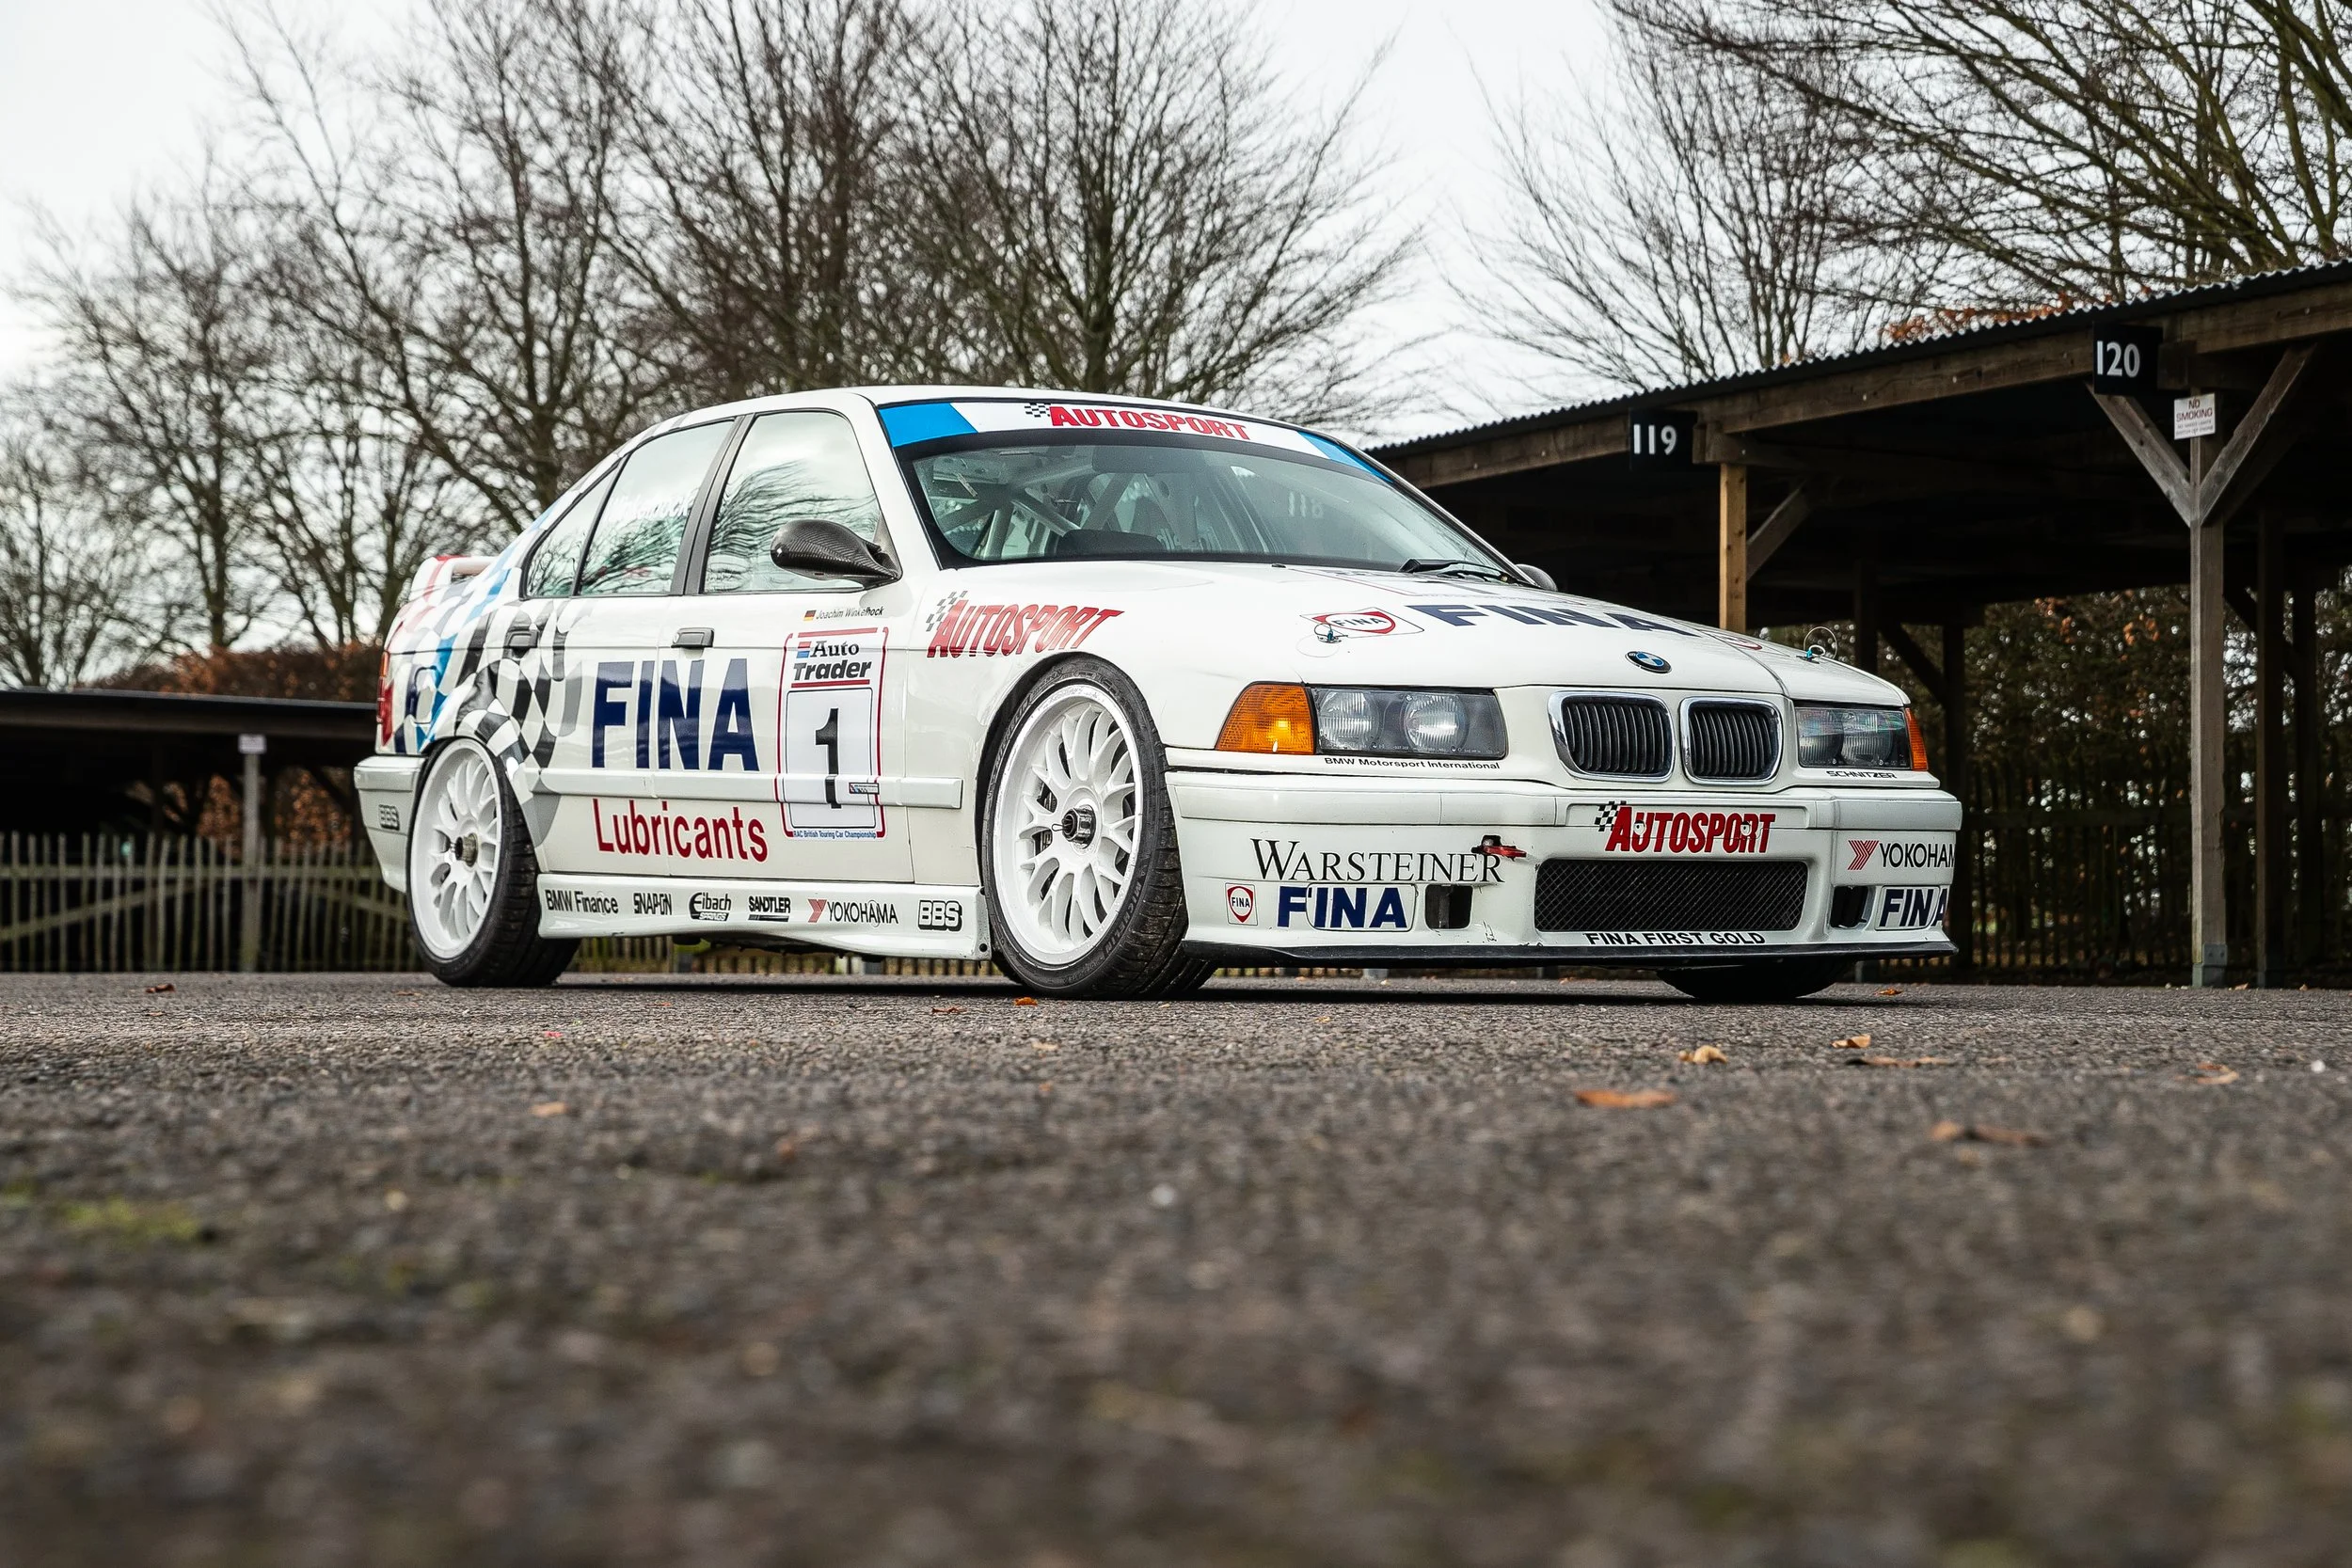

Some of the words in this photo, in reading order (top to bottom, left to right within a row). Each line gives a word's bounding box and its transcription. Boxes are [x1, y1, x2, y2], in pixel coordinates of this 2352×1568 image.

[2096, 341, 2140, 378] 120
[2176, 407, 2213, 422] SMOKING
[2188, 398, 2201, 409] NO
[1049, 405, 1250, 440] AUTOSPORT
[1633, 423, 1677, 455] 119
[816, 608, 844, 620] Joachim
[845, 606, 884, 618] Winkelhock
[1331, 617, 1388, 626] FINA
[1404, 604, 1702, 638] FINA
[927, 600, 1124, 657] AUTOSPORT
[810, 641, 860, 657] Auto
[793, 659, 872, 681] Trader
[592, 658, 760, 771] FINA
[816, 708, 841, 808] 1
[1324, 756, 1355, 766] BMW
[1359, 758, 1426, 768] Motorsport
[1427, 760, 1501, 770] International
[1826, 770, 1898, 780] SCHNITZER
[592, 799, 768, 863] Lubricants
[804, 830, 818, 838] British
[818, 830, 835, 840] Touring
[835, 830, 844, 838] Car
[845, 830, 877, 839] Championship
[1604, 806, 1776, 854] AUTOSPORT
[1250, 837, 1505, 883] WARSTEINER
[545, 889, 573, 912] BMW
[574, 891, 619, 914] Finance
[689, 892, 732, 914] Eibach
[748, 895, 791, 914] SANDTLER
[827, 899, 899, 925] YOKOHAMA
[1232, 896, 1250, 909] FINA
[1277, 886, 1408, 929] FINA
[1879, 888, 1948, 927] FINA
[918, 899, 962, 931] BBS
[1584, 932, 1641, 945] FINA
[1642, 932, 1705, 945] FIRST
[1708, 932, 1766, 944] GOLD
